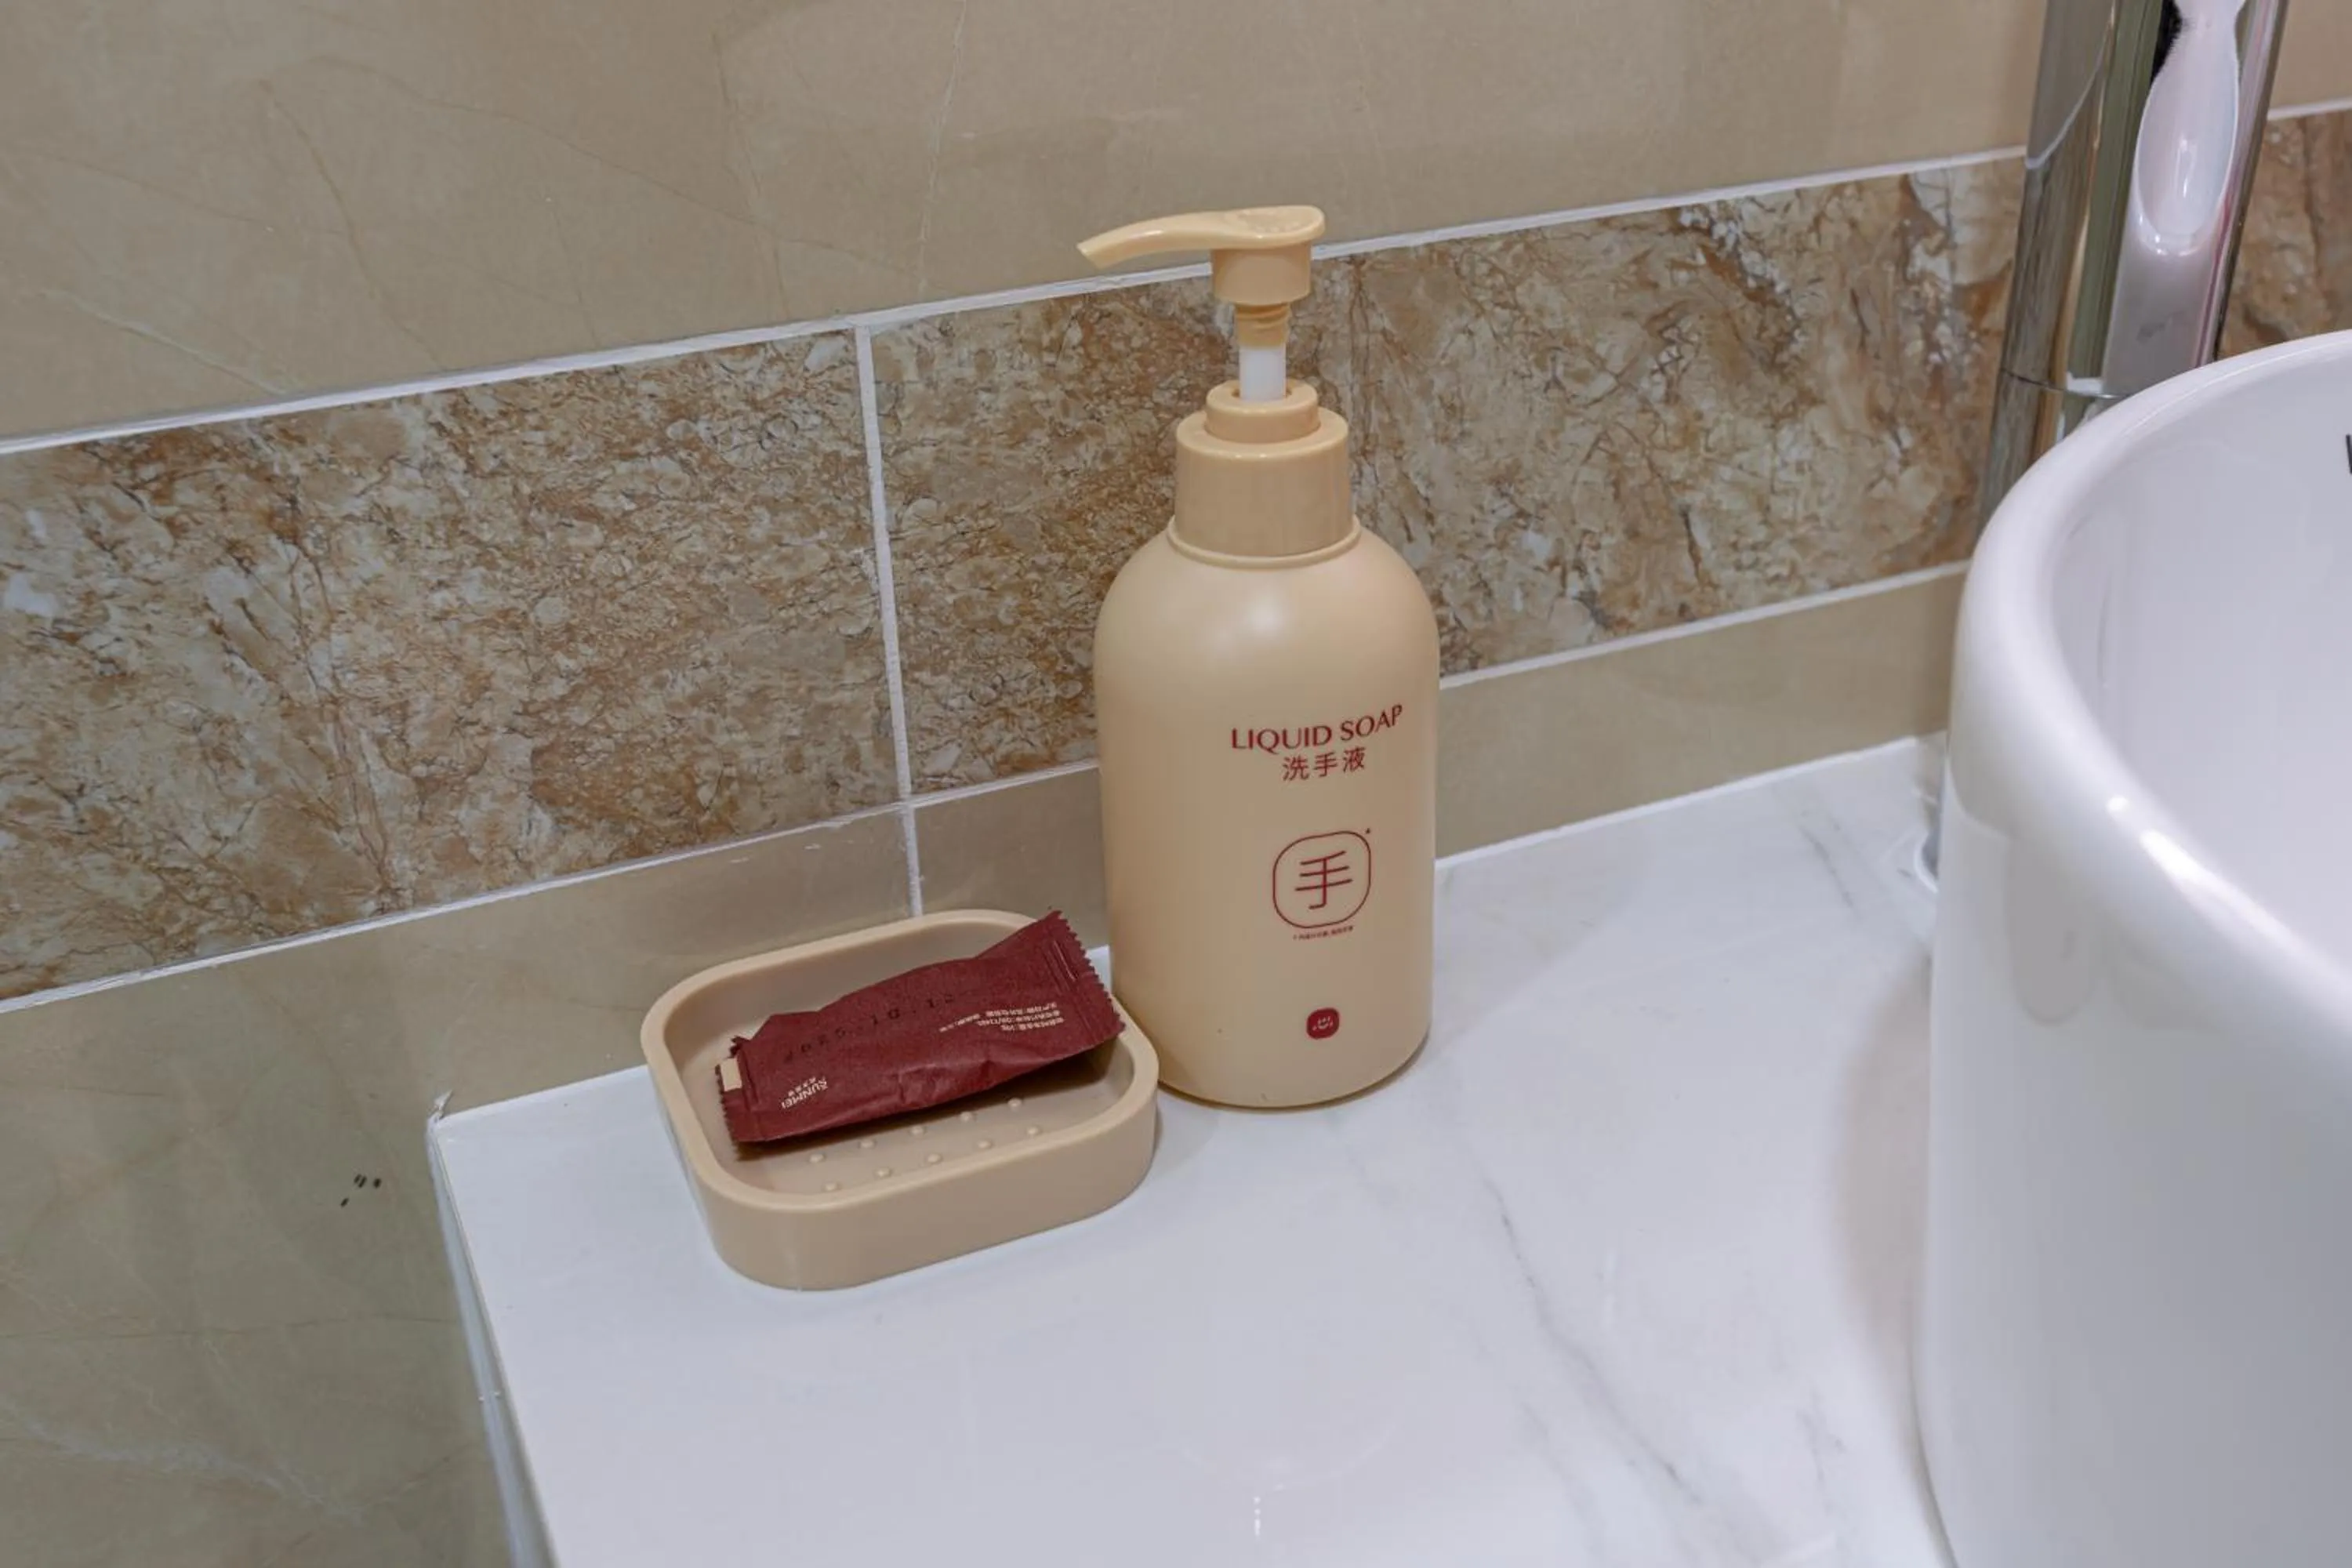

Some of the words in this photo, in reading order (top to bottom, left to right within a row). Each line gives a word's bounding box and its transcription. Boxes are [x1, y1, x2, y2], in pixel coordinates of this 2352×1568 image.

[1231, 725, 1333, 754] LIQUID
[1340, 703, 1403, 741] SOAP
[1283, 746, 1367, 782] 洗手液
[1295, 850, 1353, 909] 手
